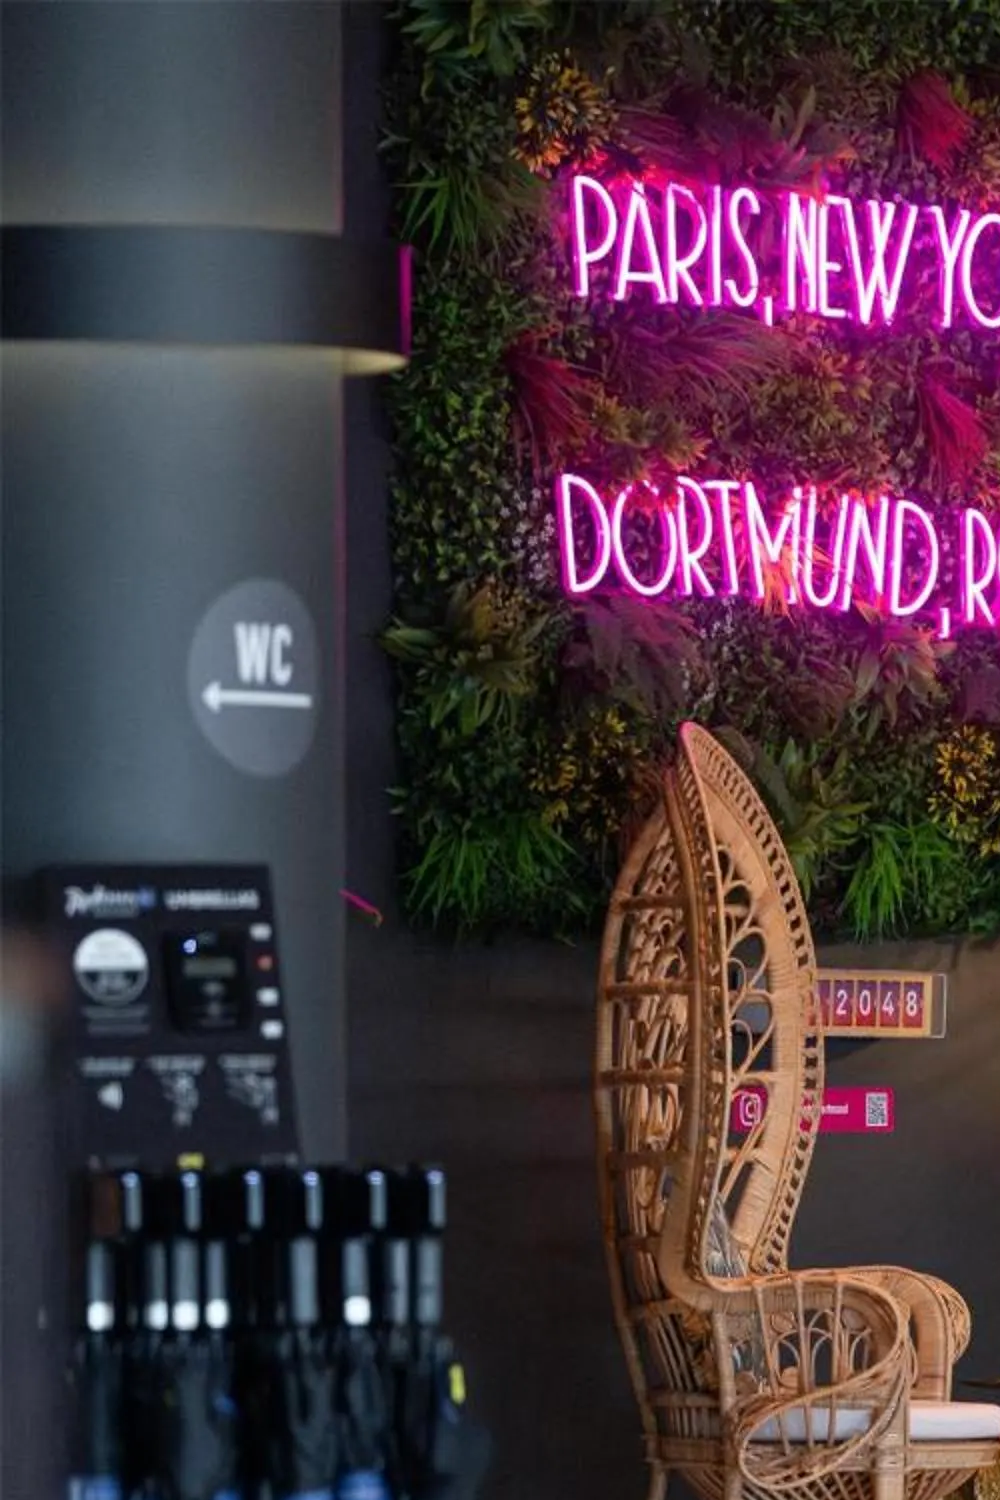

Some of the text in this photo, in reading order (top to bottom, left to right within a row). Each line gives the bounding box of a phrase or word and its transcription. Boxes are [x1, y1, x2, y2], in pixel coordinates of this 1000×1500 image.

[573, 175, 774, 327] PARIS,
[786, 192, 919, 326] NEW
[560, 472, 951, 639] DORTMUND,
[234, 621, 293, 686] WC
